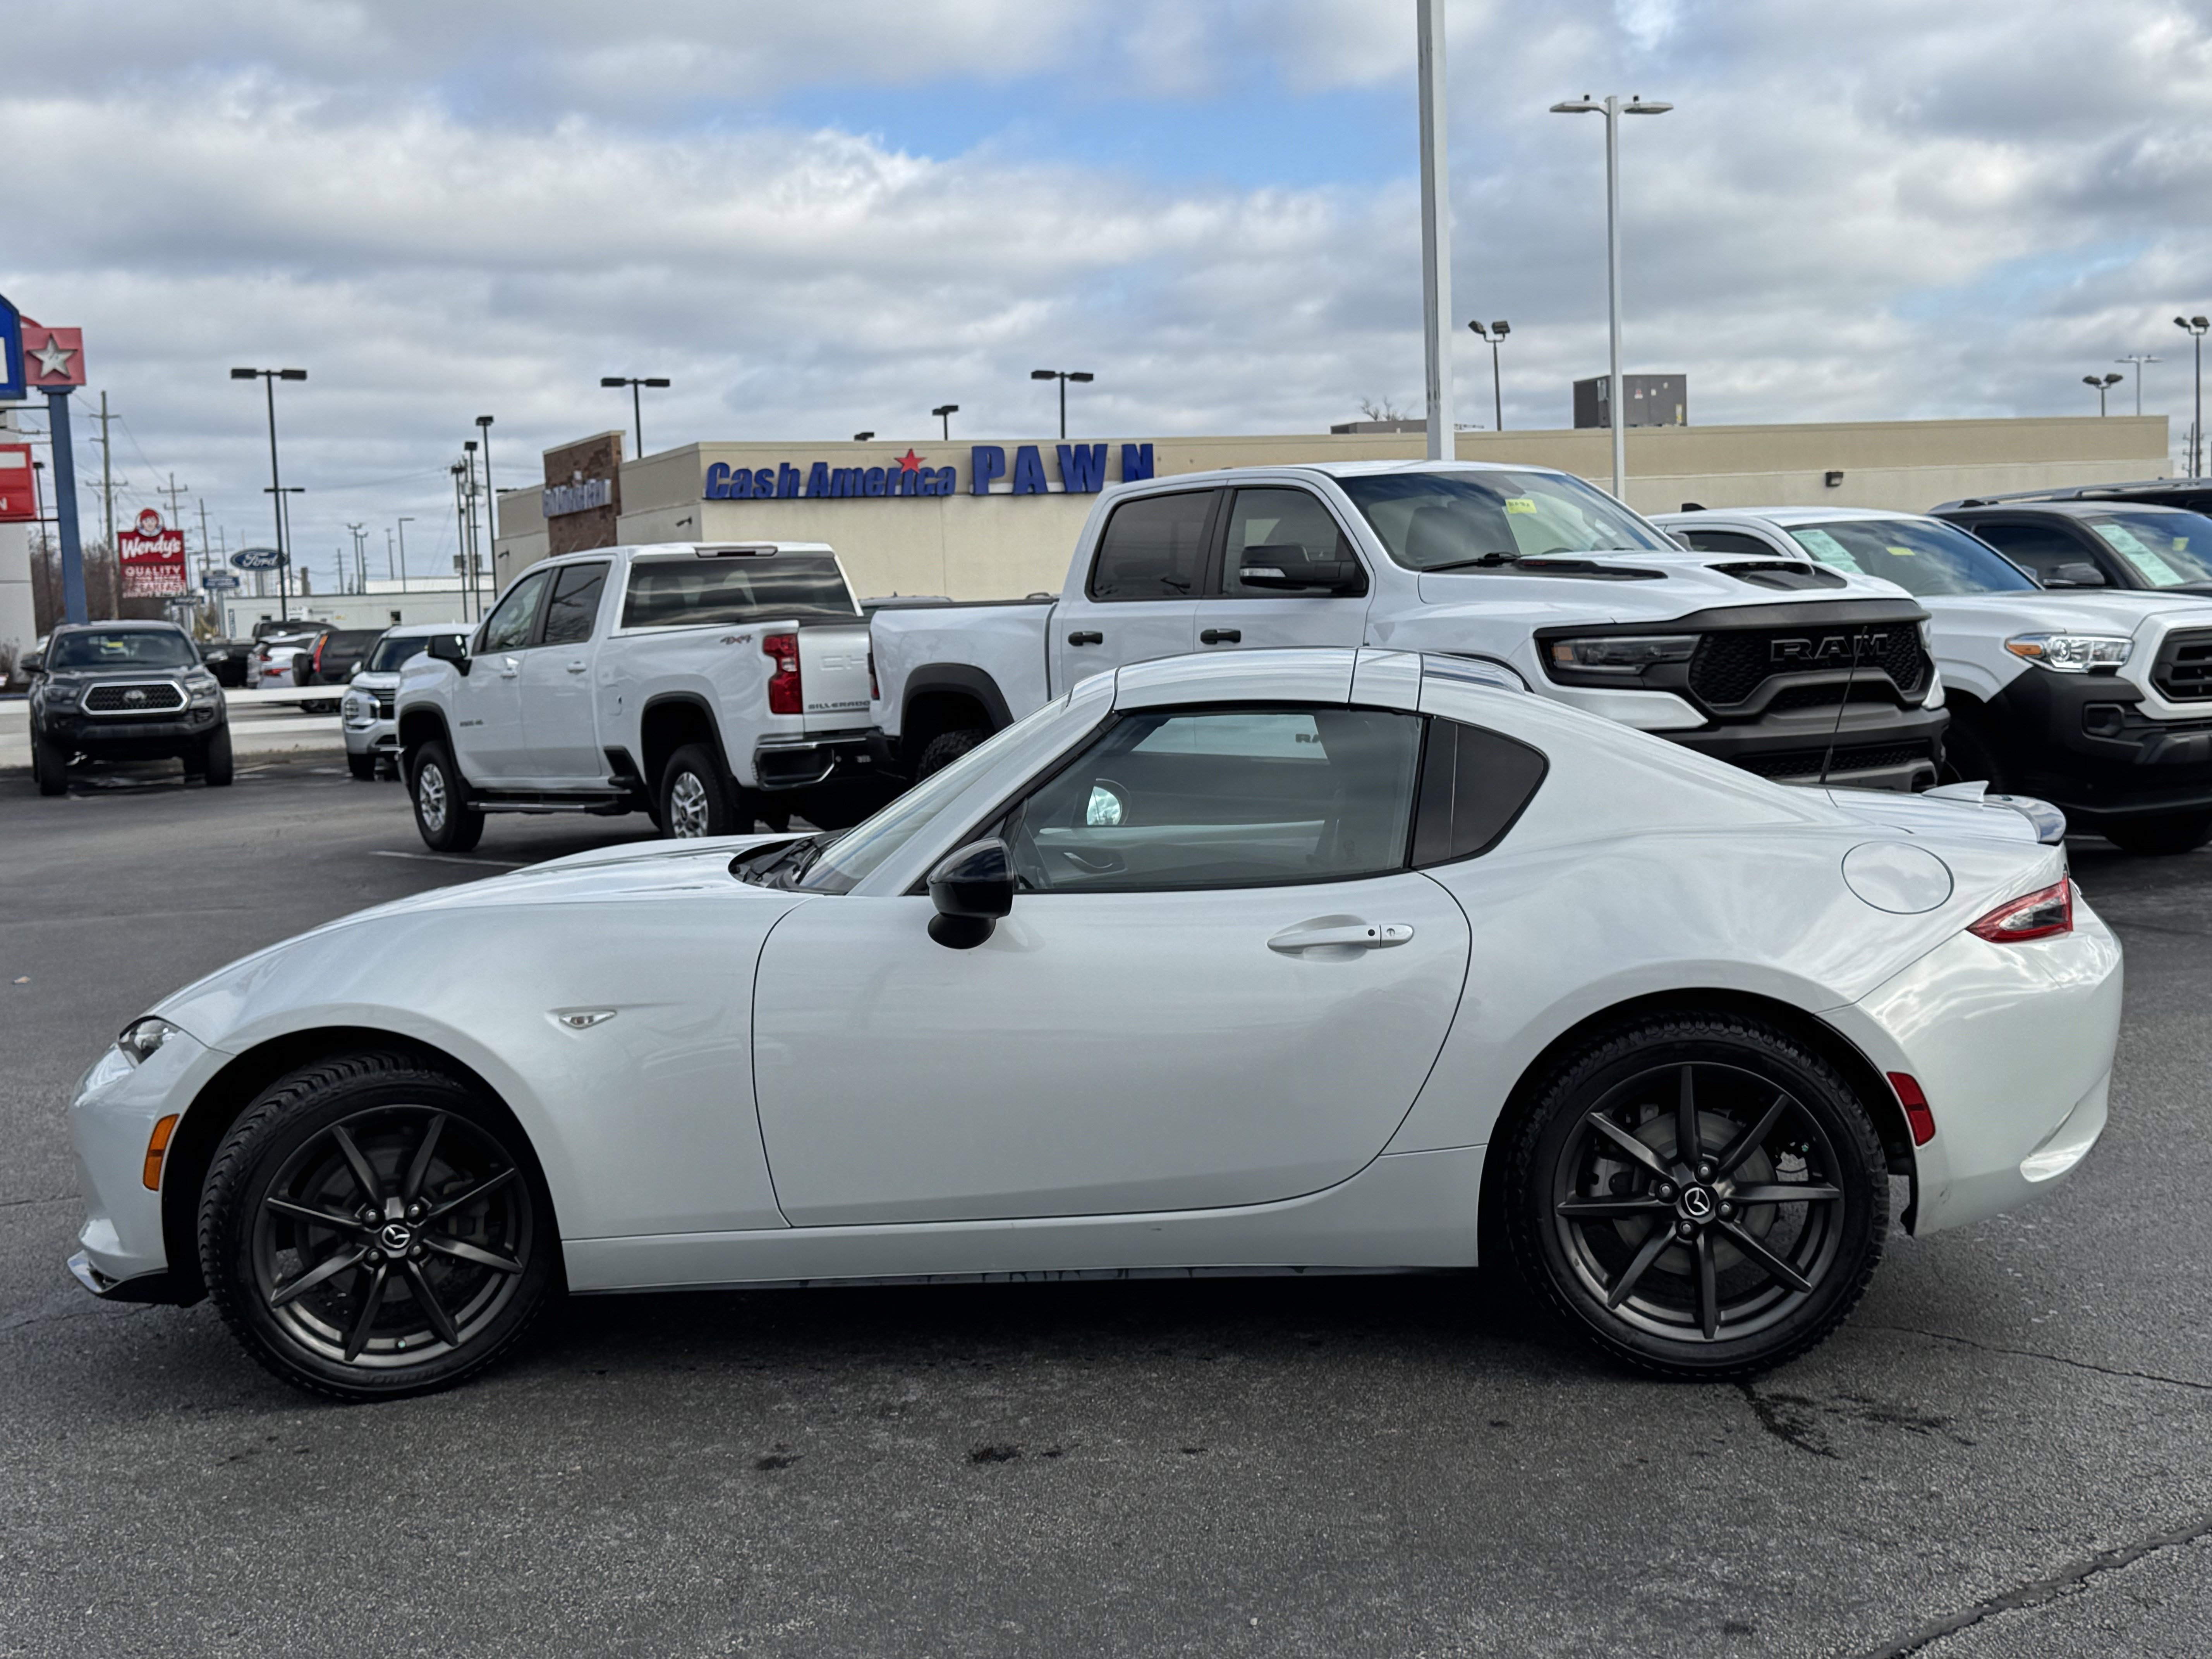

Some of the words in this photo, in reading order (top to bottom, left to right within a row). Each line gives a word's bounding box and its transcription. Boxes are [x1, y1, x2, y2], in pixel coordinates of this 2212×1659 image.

[706, 462, 800, 498] Cash
[806, 462, 956, 497] America
[972, 443, 1154, 495] PAWN
[122, 534, 181, 560] Wendy's
[242, 552, 279, 567] Ford
[125, 565, 181, 577] QUALITY
[1771, 634, 1888, 661] RAM
